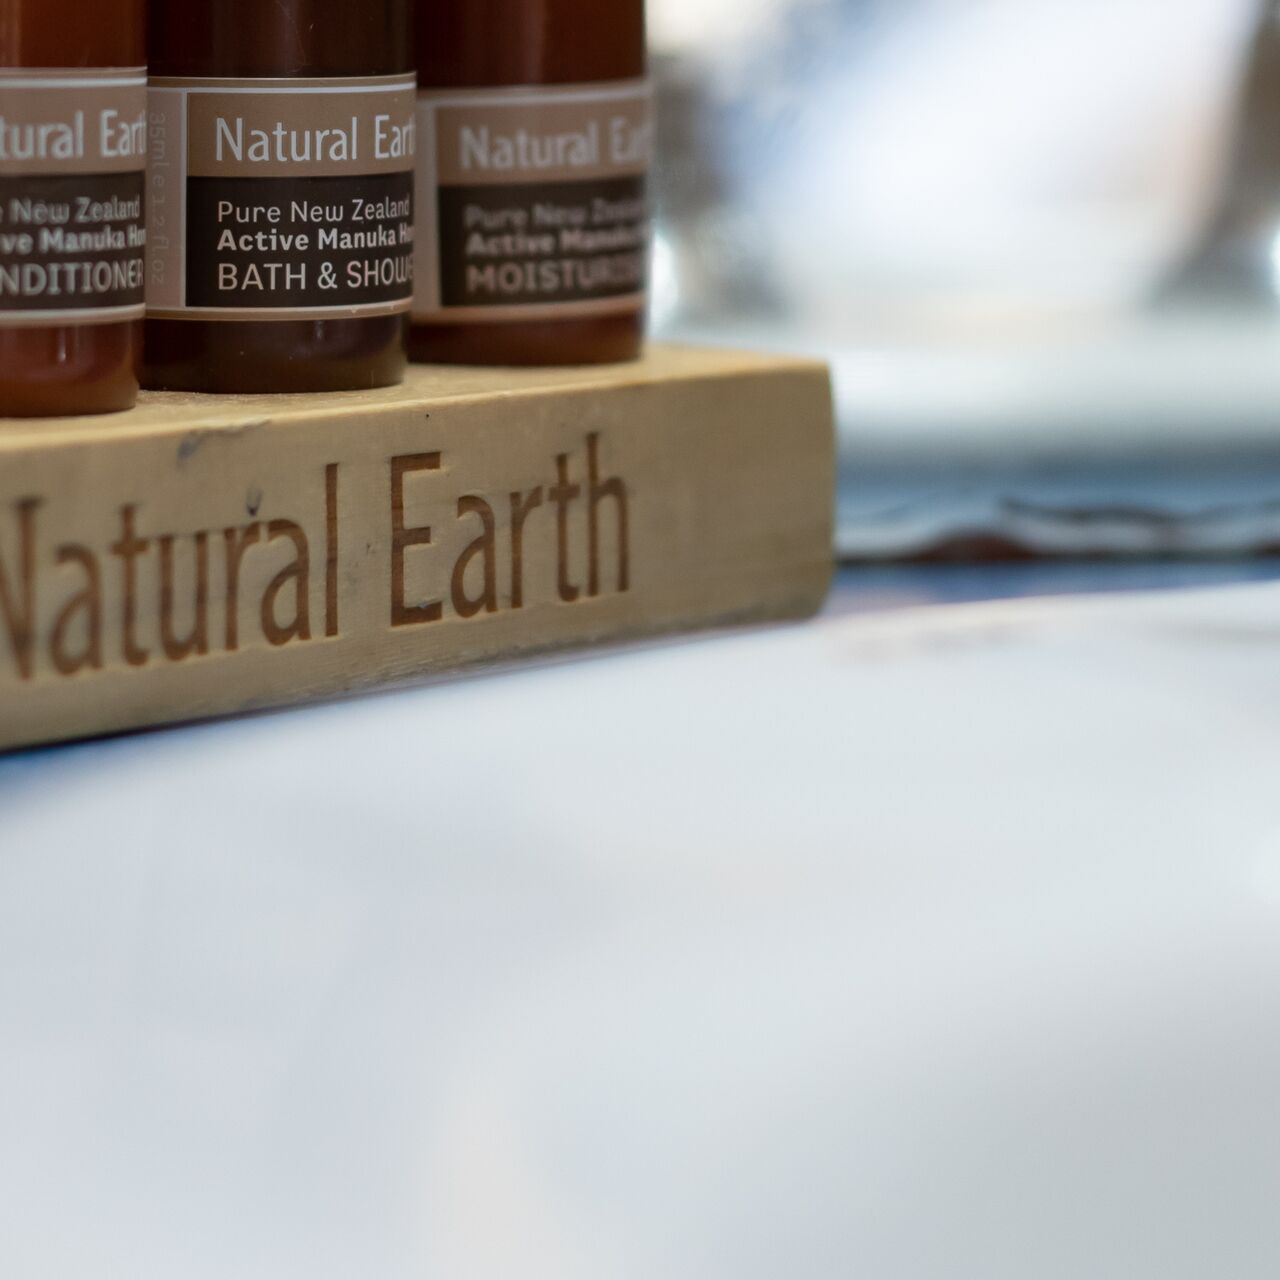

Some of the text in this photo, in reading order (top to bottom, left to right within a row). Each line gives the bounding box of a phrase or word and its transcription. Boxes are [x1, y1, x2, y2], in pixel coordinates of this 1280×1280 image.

[100, 109, 146, 158] Eart
[215, 114, 416, 162] Natural Eart
[459, 124, 599, 170] Natural
[10, 198, 70, 225] New
[76, 195, 140, 223] Zealand
[217, 195, 410, 223] Pure New Zealand
[38, 224, 125, 253] Manuka
[216, 229, 309, 251] Active
[317, 225, 397, 250] Manuka
[465, 232, 554, 256] Active
[218, 263, 306, 291] BATH
[317, 262, 338, 290] &
[389, 431, 632, 627] Earth
